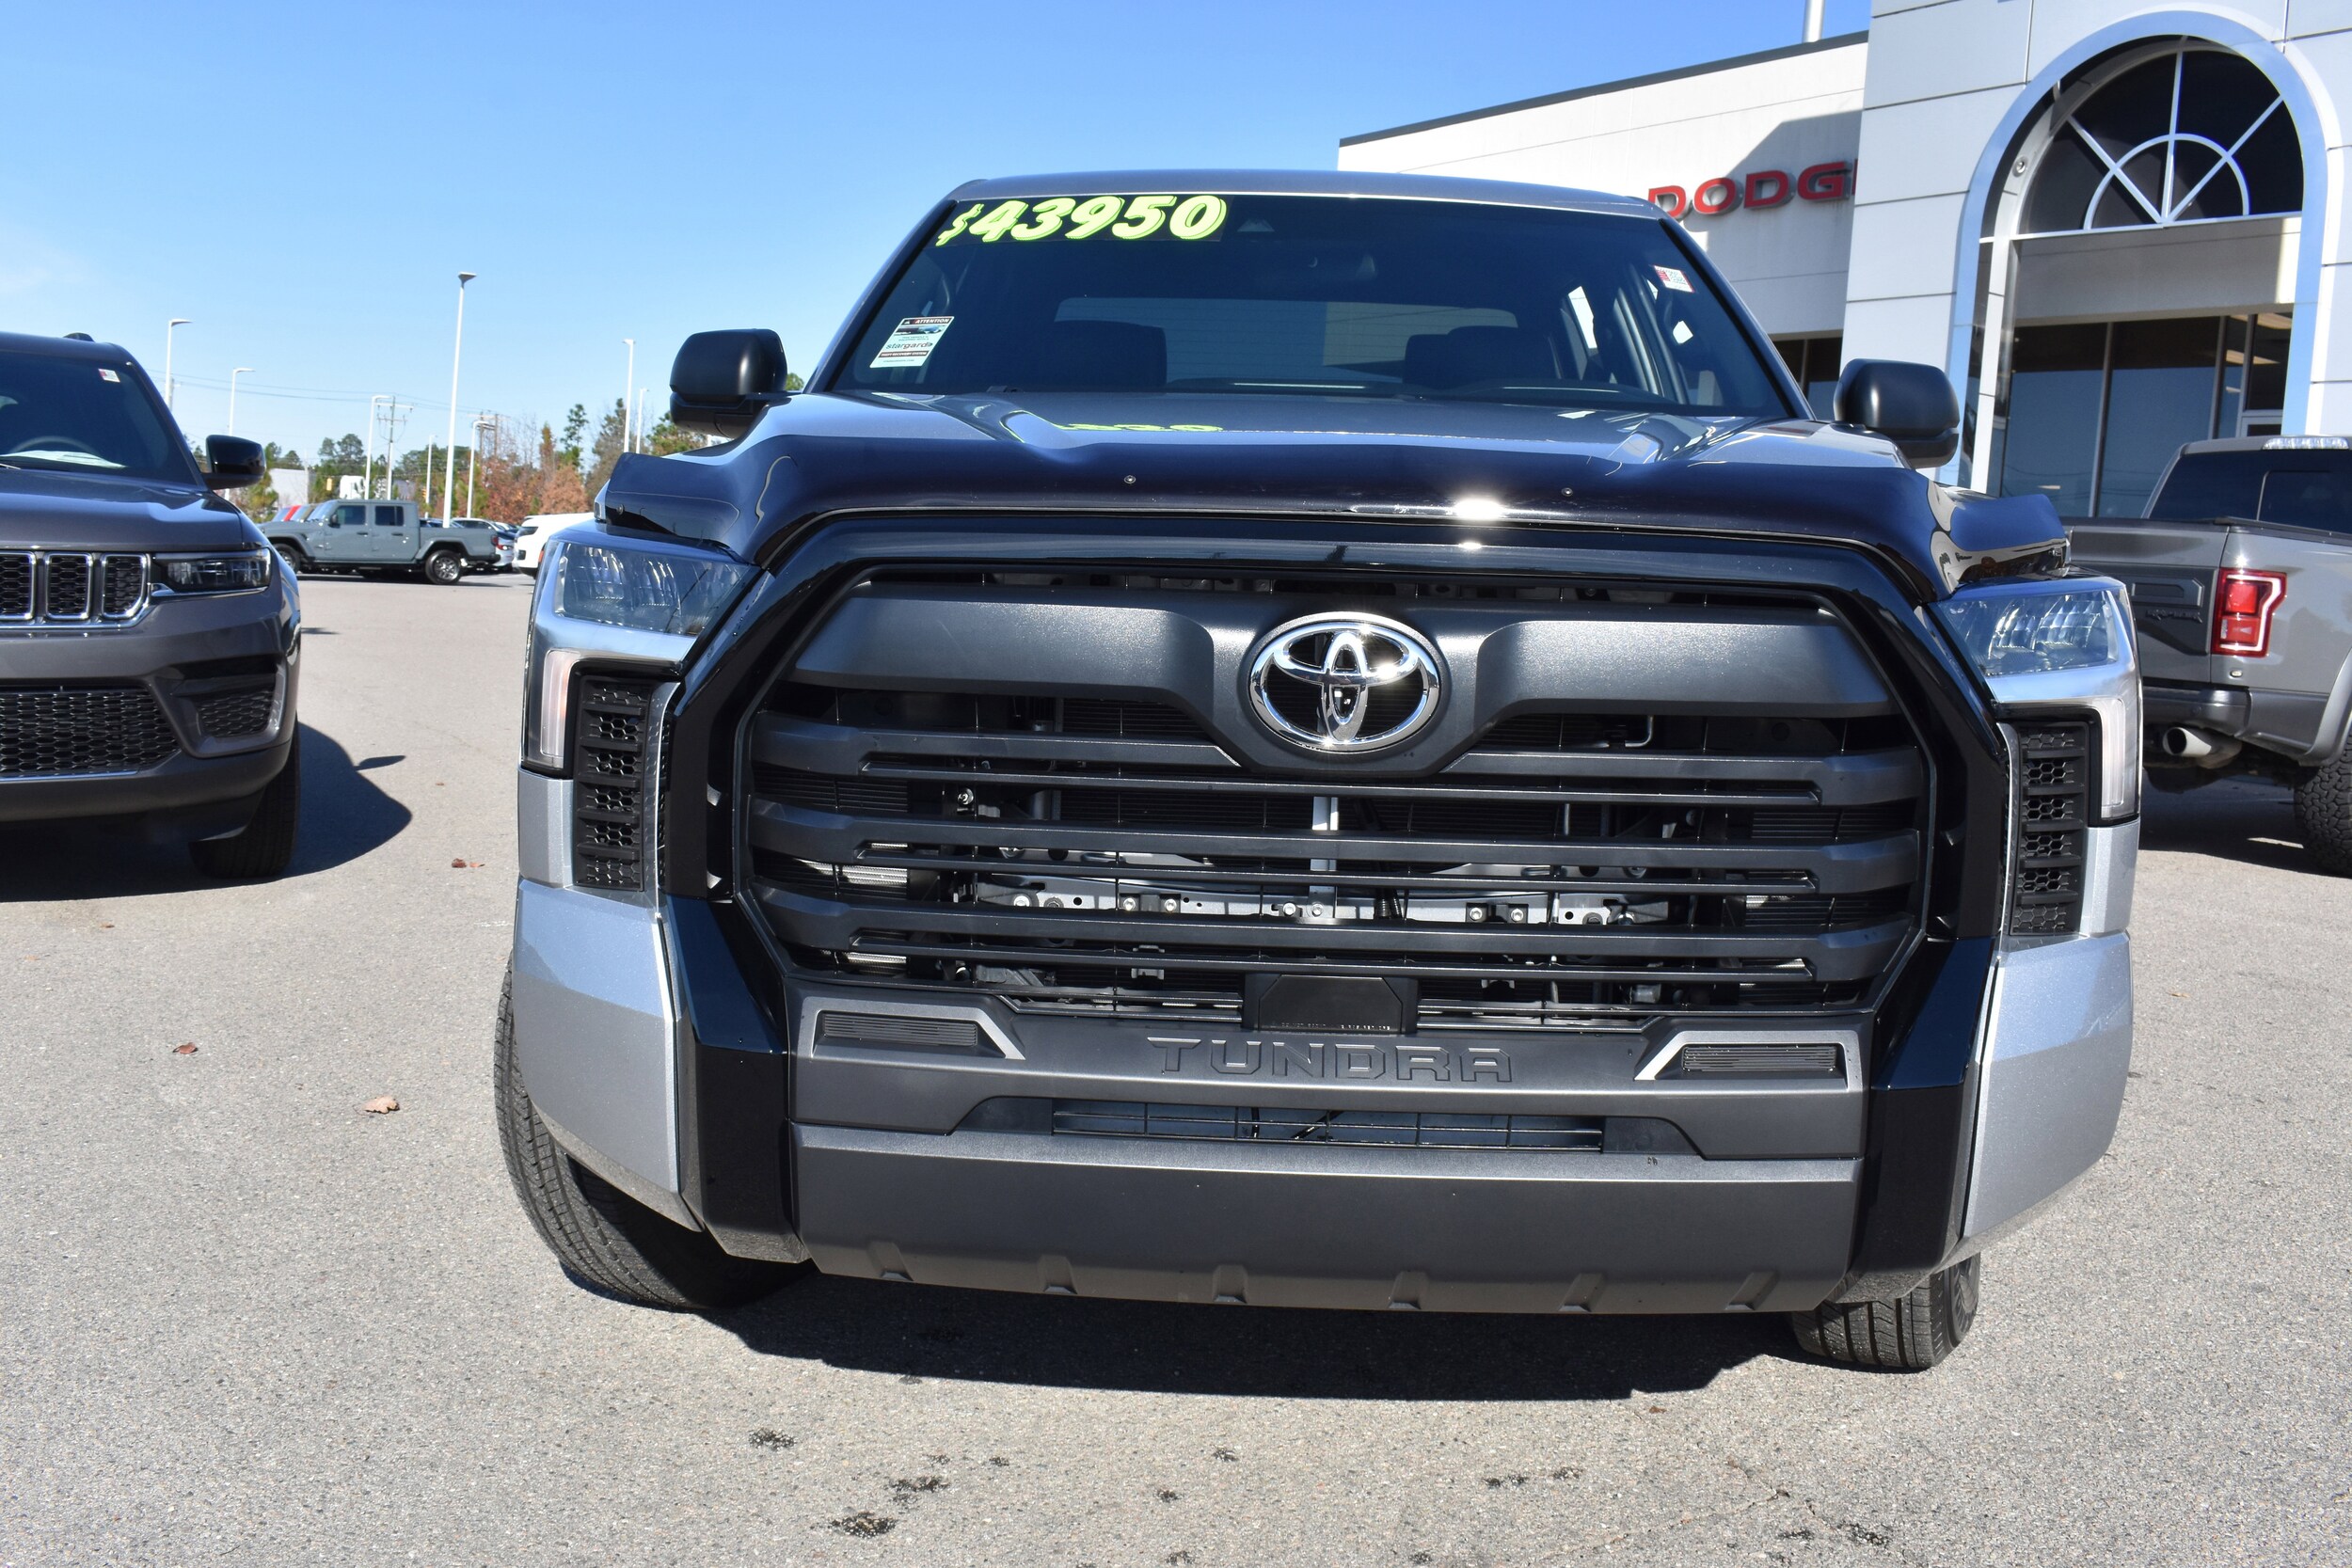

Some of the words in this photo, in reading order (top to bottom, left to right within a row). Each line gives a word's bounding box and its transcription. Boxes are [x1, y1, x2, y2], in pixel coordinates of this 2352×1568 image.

[1647, 159, 1859, 217] DODG
[935, 195, 1227, 246] $43950
[1147, 1037, 1512, 1083] TUNDRA
